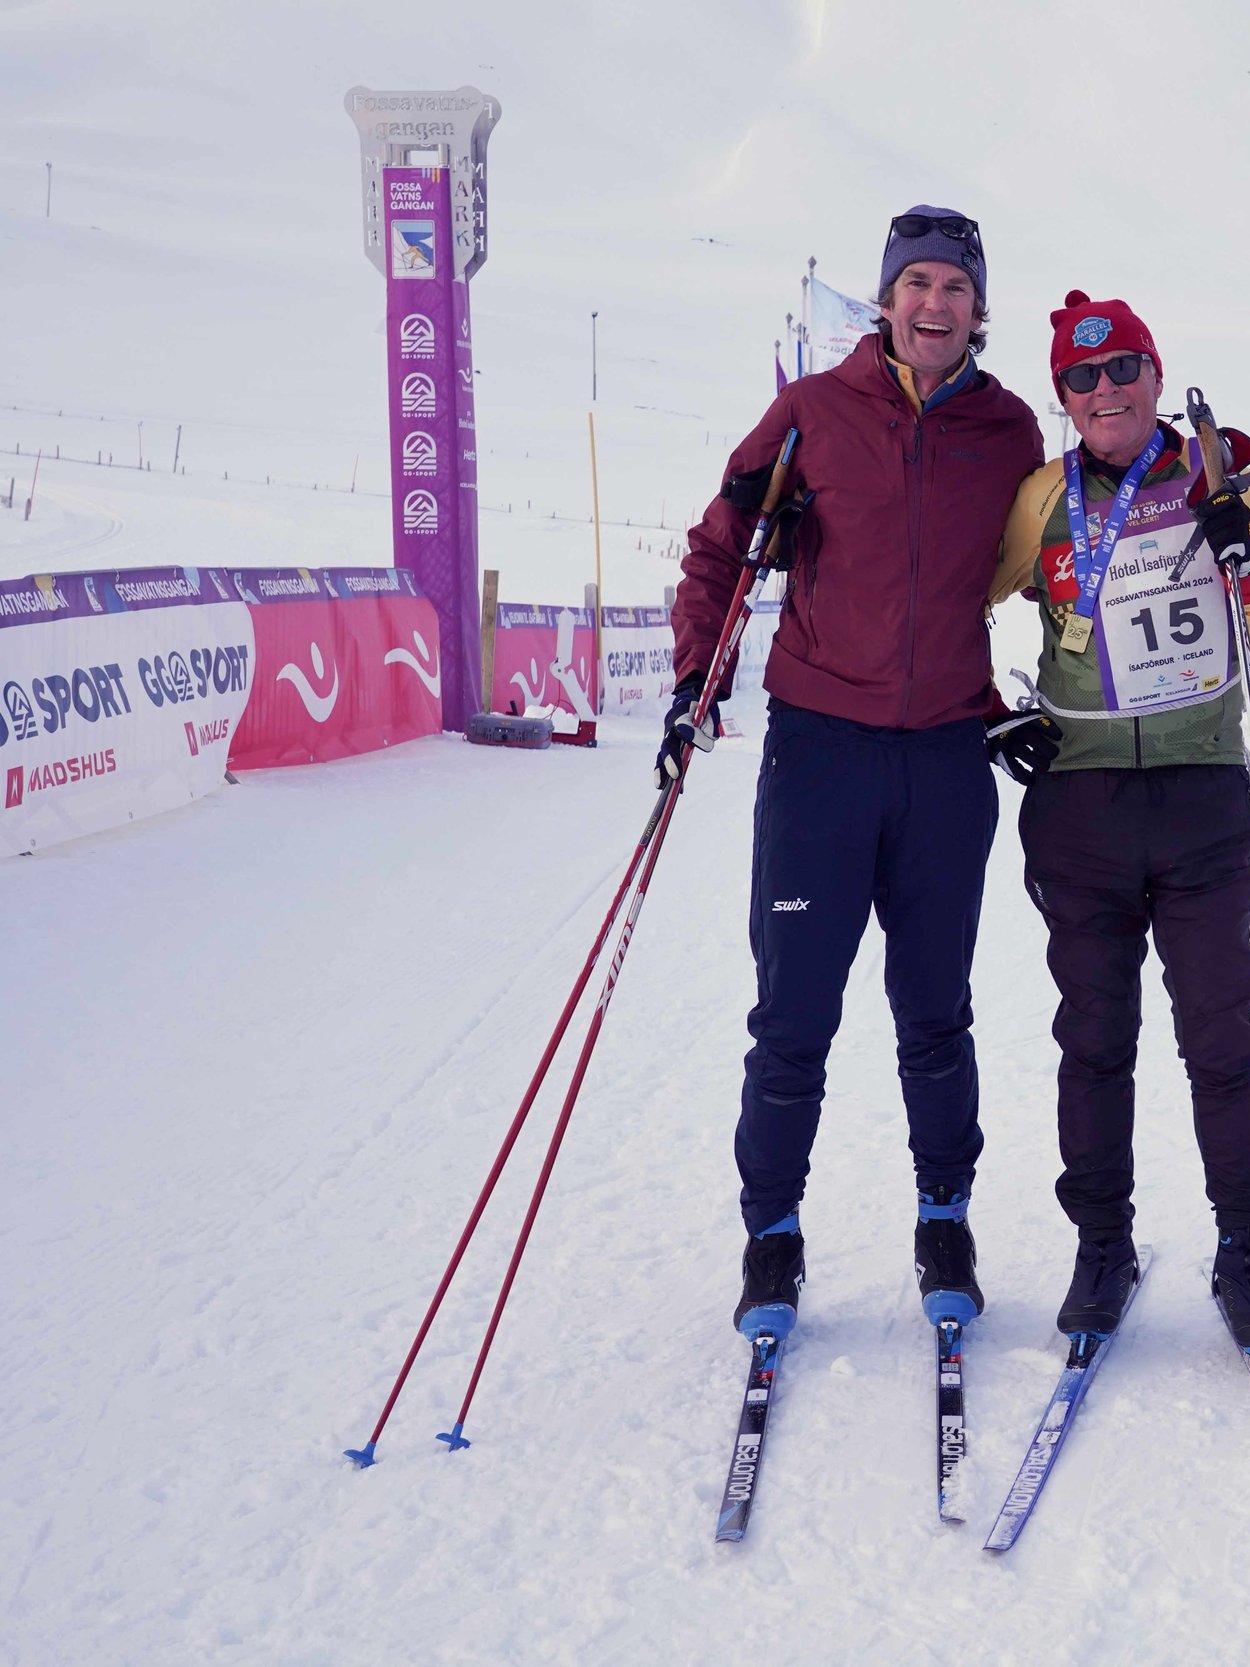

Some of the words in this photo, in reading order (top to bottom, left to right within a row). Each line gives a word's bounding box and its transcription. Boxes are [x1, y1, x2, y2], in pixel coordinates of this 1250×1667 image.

[390, 182, 422, 192] FOSSA
[390, 191, 422, 201] VATNS
[390, 200, 434, 211] GANGAN
[1076, 322, 1107, 341] PARALLEL
[1143, 498, 1184, 517] SKAUT
[1127, 520, 1140, 528] VEL
[1108, 558, 1141, 582] Hótel
[115, 579, 201, 602] FOSSAVATNSGANGAN
[1105, 581, 1191, 608] FOSSAVATNSGANGAN
[1192, 576, 1214, 587] 2024
[1130, 597, 1205, 652] 15
[1128, 656, 1175, 672] ÍSAFJÖRÐUR
[1182, 648, 1214, 661] ICELAND
[190, 645, 248, 699] SPORT
[32, 663, 132, 735] SPORT
[1142, 692, 1161, 701] SPORT
[27, 749, 117, 793] MADSHUS
[727, 1443, 760, 1501] salomon
